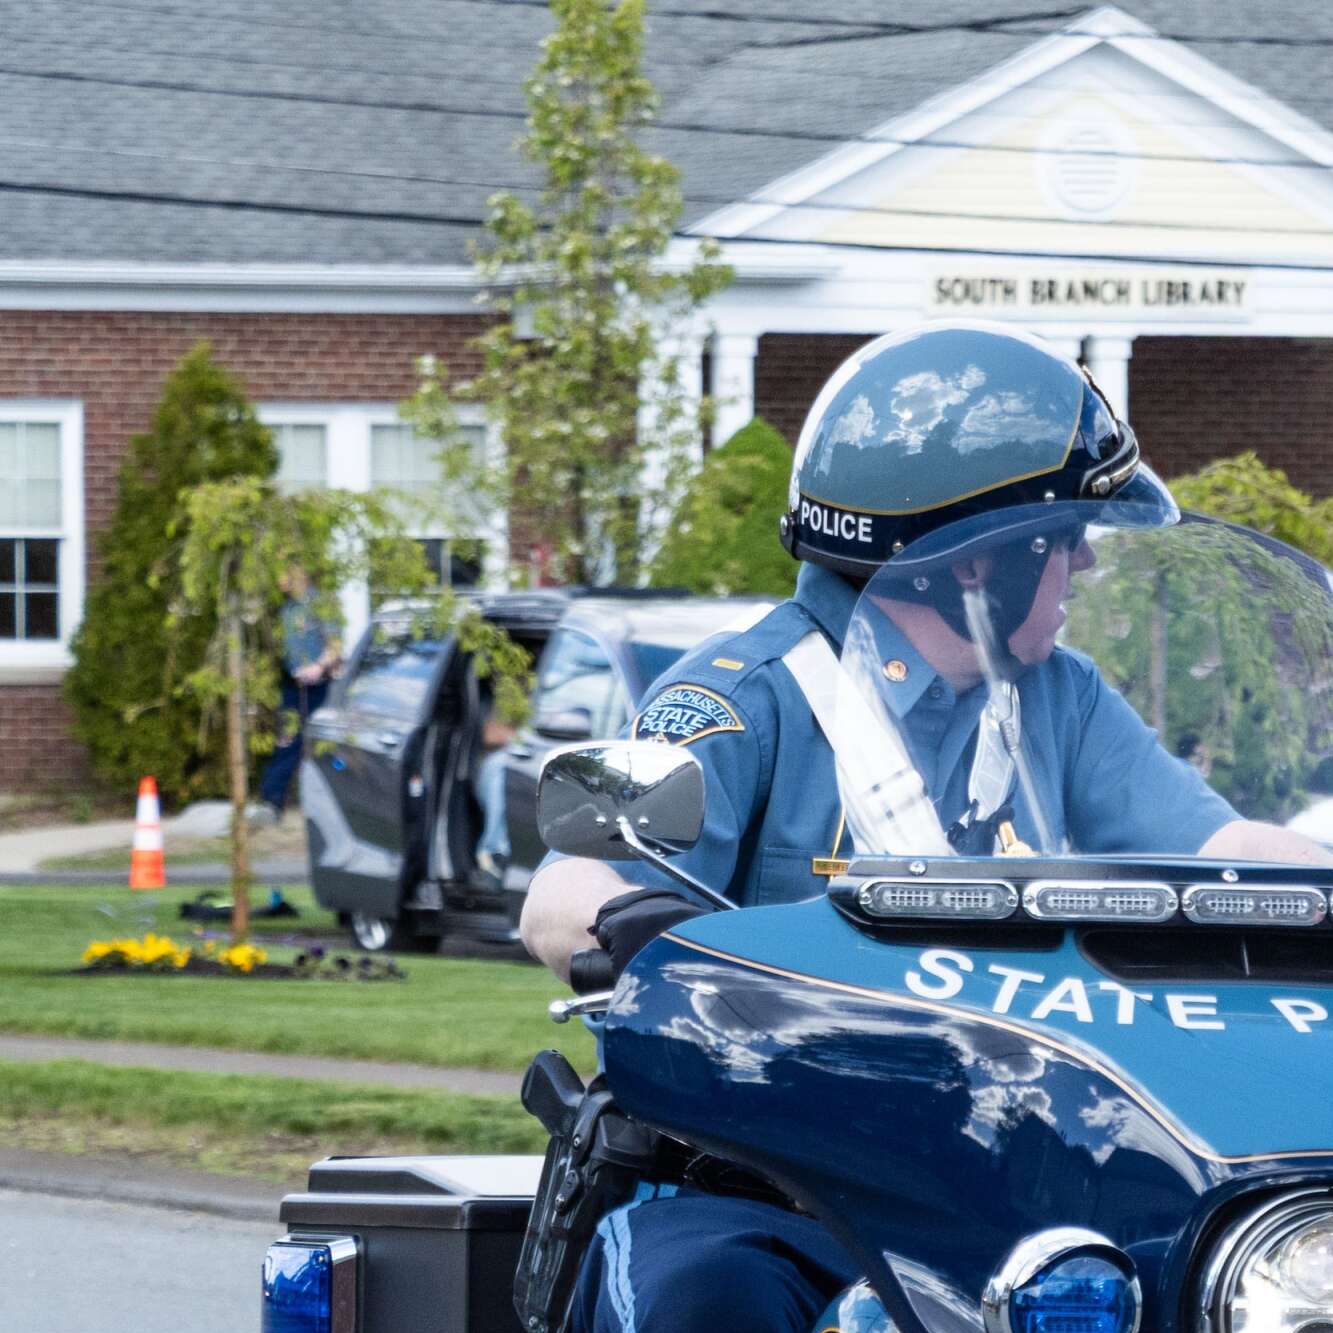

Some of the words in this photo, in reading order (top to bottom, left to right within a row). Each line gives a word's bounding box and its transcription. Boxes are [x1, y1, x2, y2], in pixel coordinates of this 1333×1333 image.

[934, 277, 1016, 305] SOUTH
[1030, 279, 1131, 306] BRANCH
[1141, 279, 1246, 306] LIBRARY
[800, 500, 873, 543] POLICE
[639, 721, 696, 737] POLICE
[643, 706, 712, 729] STATE
[904, 948, 1225, 1031] STATE
